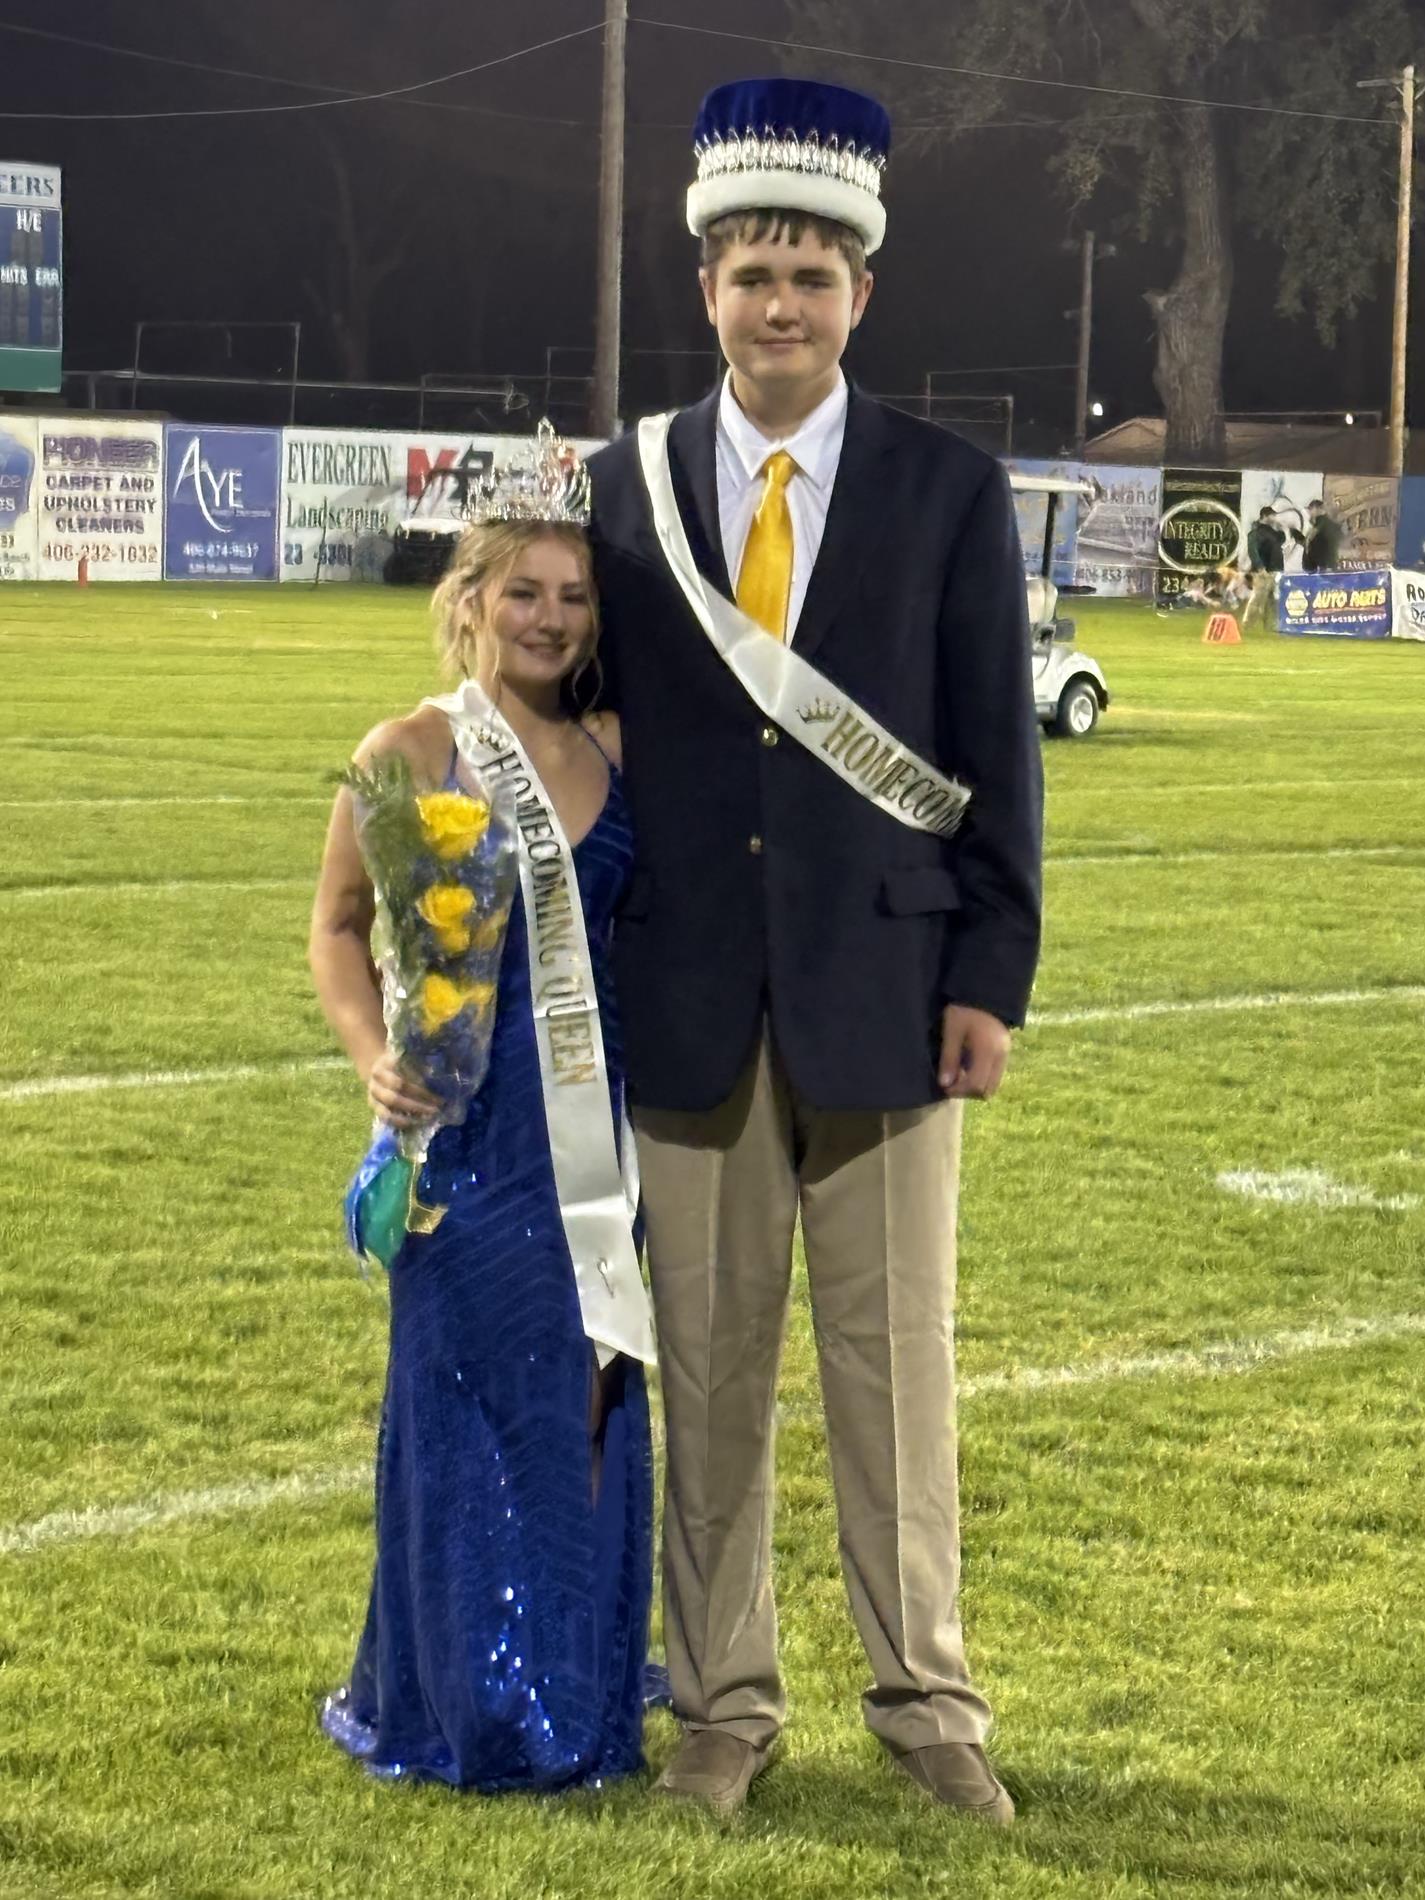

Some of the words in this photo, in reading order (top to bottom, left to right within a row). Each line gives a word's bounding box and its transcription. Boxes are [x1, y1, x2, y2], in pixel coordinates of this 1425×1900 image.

[286, 442, 391, 487] EVERGREEN
[46, 475, 112, 492] CARPET
[119, 476, 155, 493] AND
[44, 496, 157, 513] UPHOLSTERY
[55, 517, 145, 535] CLEANERS
[1164, 520, 1235, 541] INTEGRITY
[1184, 541, 1234, 560] REALTY
[1312, 589, 1348, 609] AUTO
[1350, 587, 1386, 607] PARTS
[480, 749, 575, 967] HOMECOMING
[538, 976, 598, 1087] QUEEN
